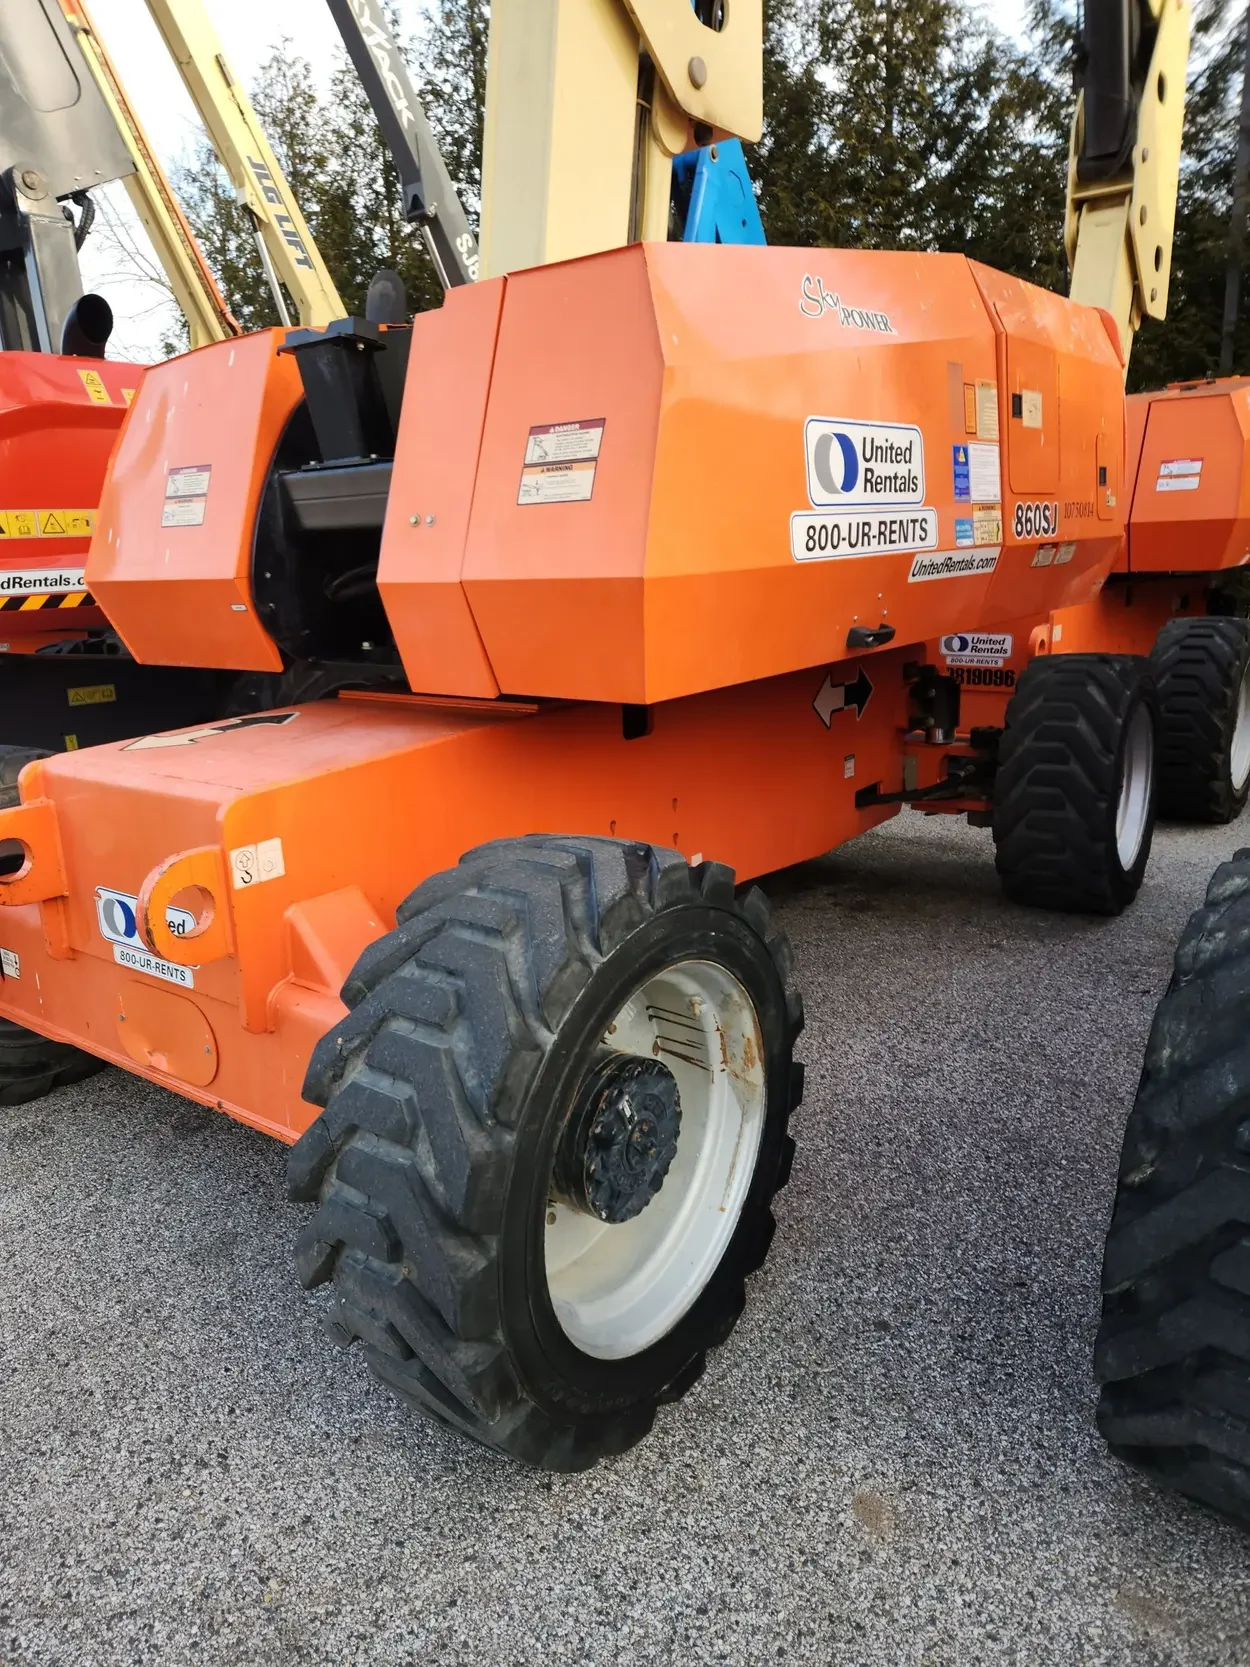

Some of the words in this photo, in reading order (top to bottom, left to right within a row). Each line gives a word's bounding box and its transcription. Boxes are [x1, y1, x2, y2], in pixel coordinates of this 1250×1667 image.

[246, 155, 283, 205] JLG
[273, 213, 314, 270] LIFT
[841, 307, 893, 332] POWER
[554, 423, 581, 433] DANGER
[862, 436, 913, 464] United
[546, 464, 573, 473] WARNING
[863, 467, 918, 493] Rentals
[1015, 503, 1058, 538] 860SJ
[805, 517, 928, 552] 800-UR-RENTS
[911, 555, 997, 578] UnitedRentals.com
[970, 645, 1008, 655] Rentals
[971, 636, 1006, 646] United
[950, 657, 999, 666] 800-UR-RENTS
[167, 919, 186, 935] ed
[120, 950, 186, 982] 800-UR-RENTS
